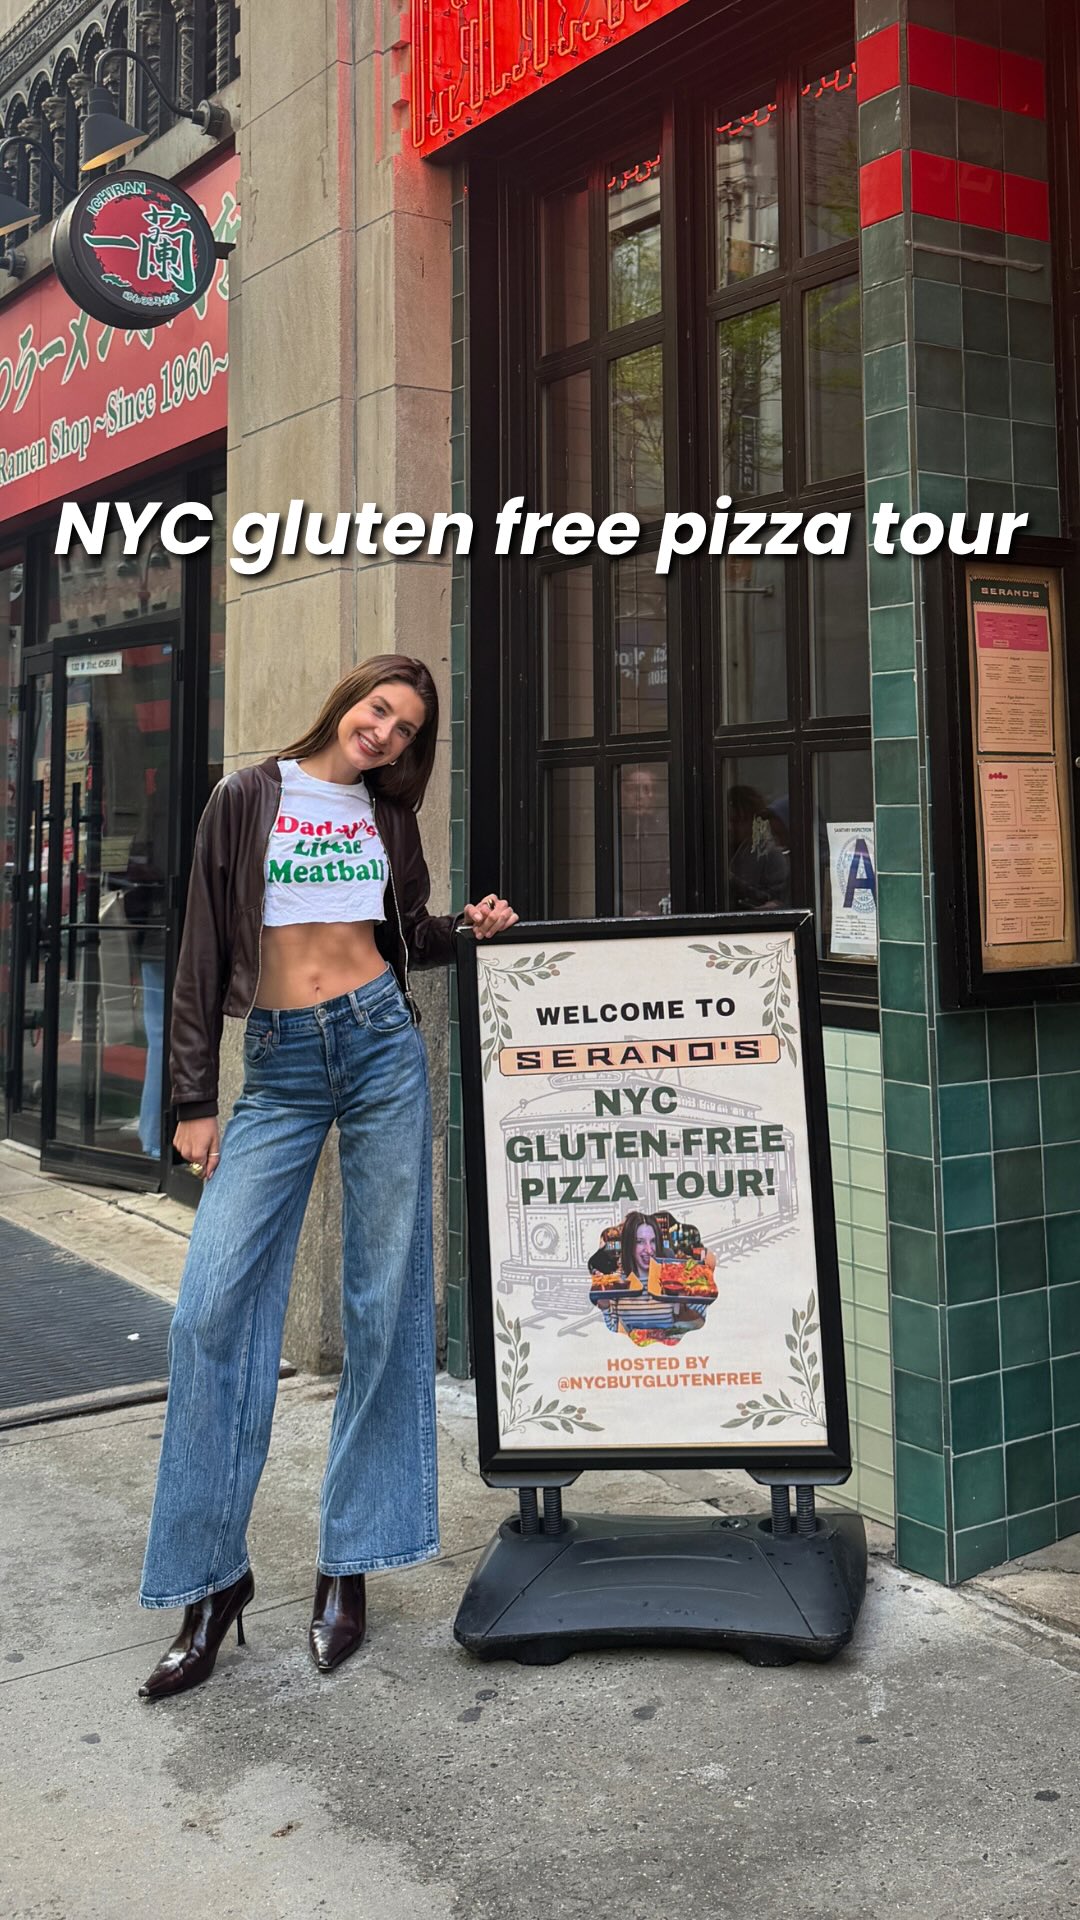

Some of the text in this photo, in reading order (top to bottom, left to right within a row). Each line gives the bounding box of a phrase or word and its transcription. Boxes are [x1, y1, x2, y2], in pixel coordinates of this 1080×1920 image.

[86, 181, 147, 217] ICHIRAN
[83, 203, 197, 294] 一蘭
[50, 417, 91, 464] Shop
[981, 587, 1040, 598] SERANO'S
[275, 816, 378, 839] Dady's
[267, 859, 384, 883] Meatball
[843, 838, 877, 908] A
[536, 997, 736, 1026] WELCOME TO
[516, 1040, 762, 1070] SERANO'S
[594, 1086, 678, 1117] NYC
[505, 1124, 785, 1163] GLUTEN-FREE
[521, 1168, 776, 1205] PIZZA TOUR!
[607, 1355, 710, 1371] HOSTED BY
[557, 1371, 763, 1392] @NYCBUTGLUTENFREE
